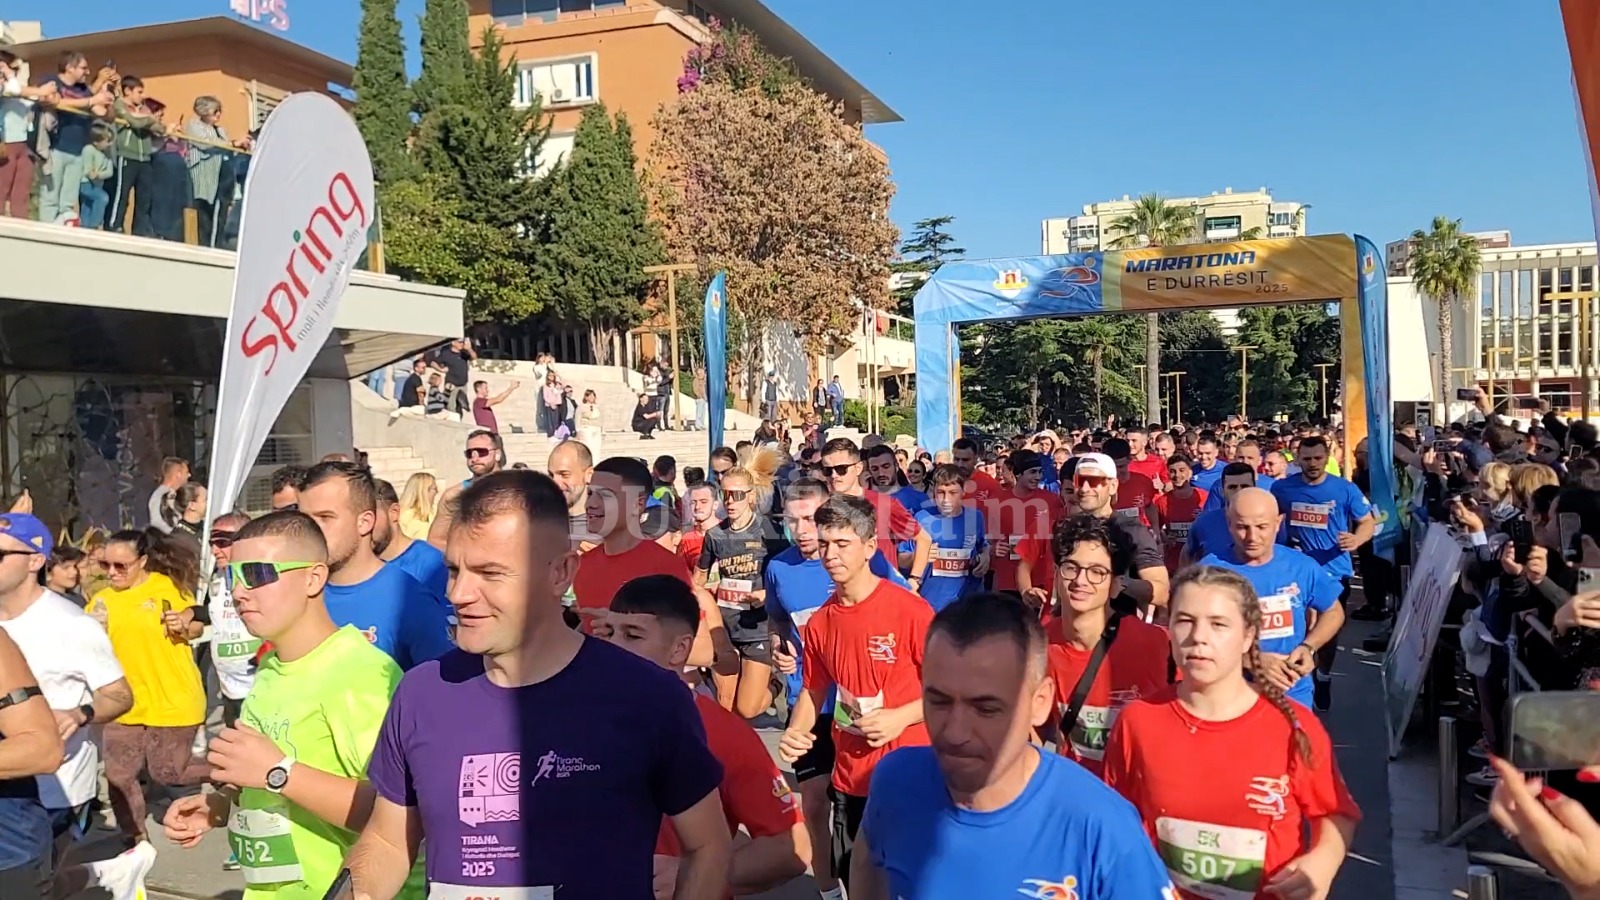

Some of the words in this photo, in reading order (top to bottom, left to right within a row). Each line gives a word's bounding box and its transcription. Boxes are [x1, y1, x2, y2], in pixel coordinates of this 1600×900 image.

[1125, 251, 1256, 273] MARATONA
[241, 172, 365, 376] spring
[1147, 278, 1158, 291] E
[1165, 270, 1268, 290] DURRËSIT
[1255, 284, 1289, 294] 2025
[1297, 512, 1323, 522] 1009
[725, 560, 758, 575] TOWN
[226, 643, 250, 655] 701
[1086, 711, 1105, 724] 5K
[461, 835, 499, 845] TIRANA
[1197, 830, 1220, 848] 5K
[234, 836, 273, 863] 752
[462, 861, 495, 877] 2025
[1182, 851, 1236, 881] 507
